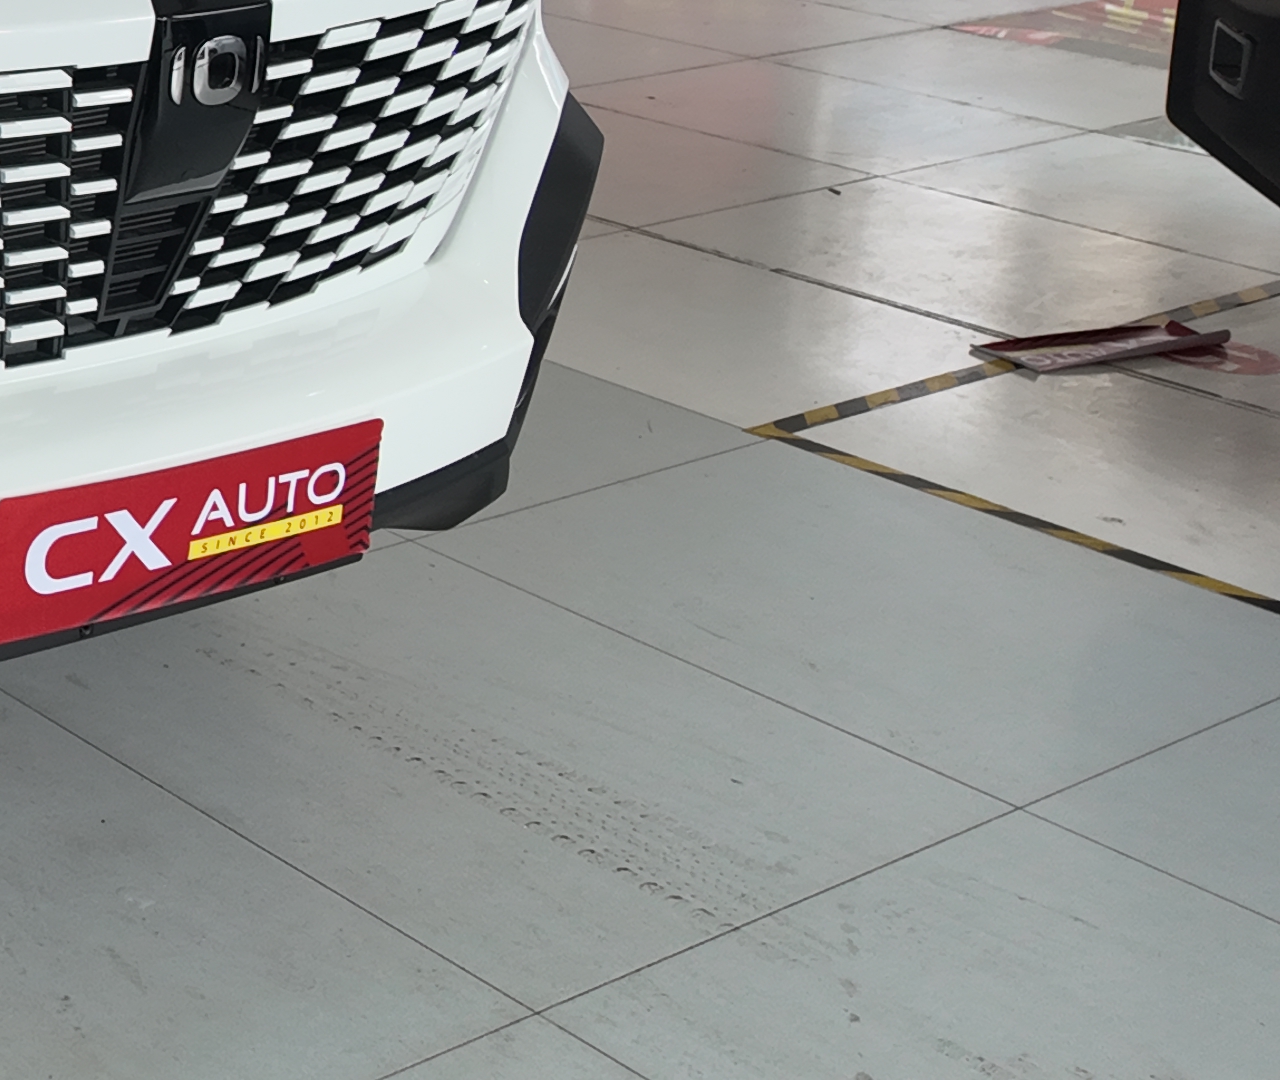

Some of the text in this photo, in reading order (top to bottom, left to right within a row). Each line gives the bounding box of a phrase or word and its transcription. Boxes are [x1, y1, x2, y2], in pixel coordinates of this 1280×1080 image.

[25, 462, 346, 595] CX AUTO
[200, 511, 336, 554] SINCE 2012
